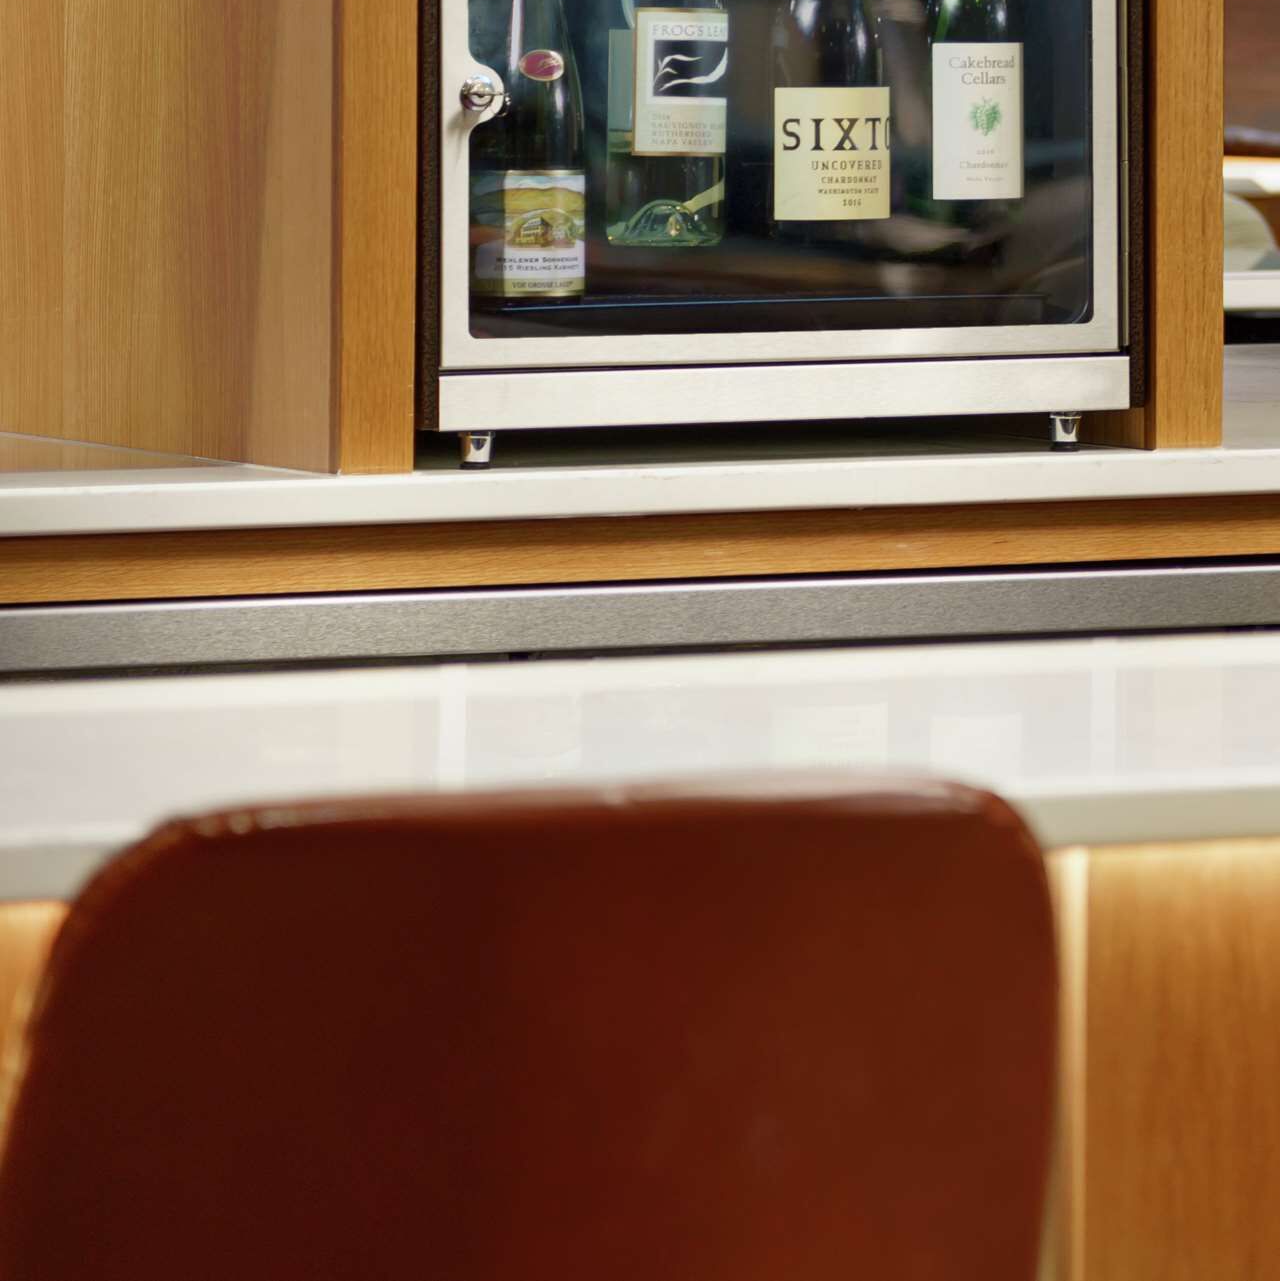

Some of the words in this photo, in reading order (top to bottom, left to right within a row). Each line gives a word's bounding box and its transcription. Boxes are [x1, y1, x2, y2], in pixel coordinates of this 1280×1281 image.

[949, 55, 1015, 70] Cakebread
[961, 72, 1006, 86] Cellars
[811, 160, 883, 171] UNCOVERED
